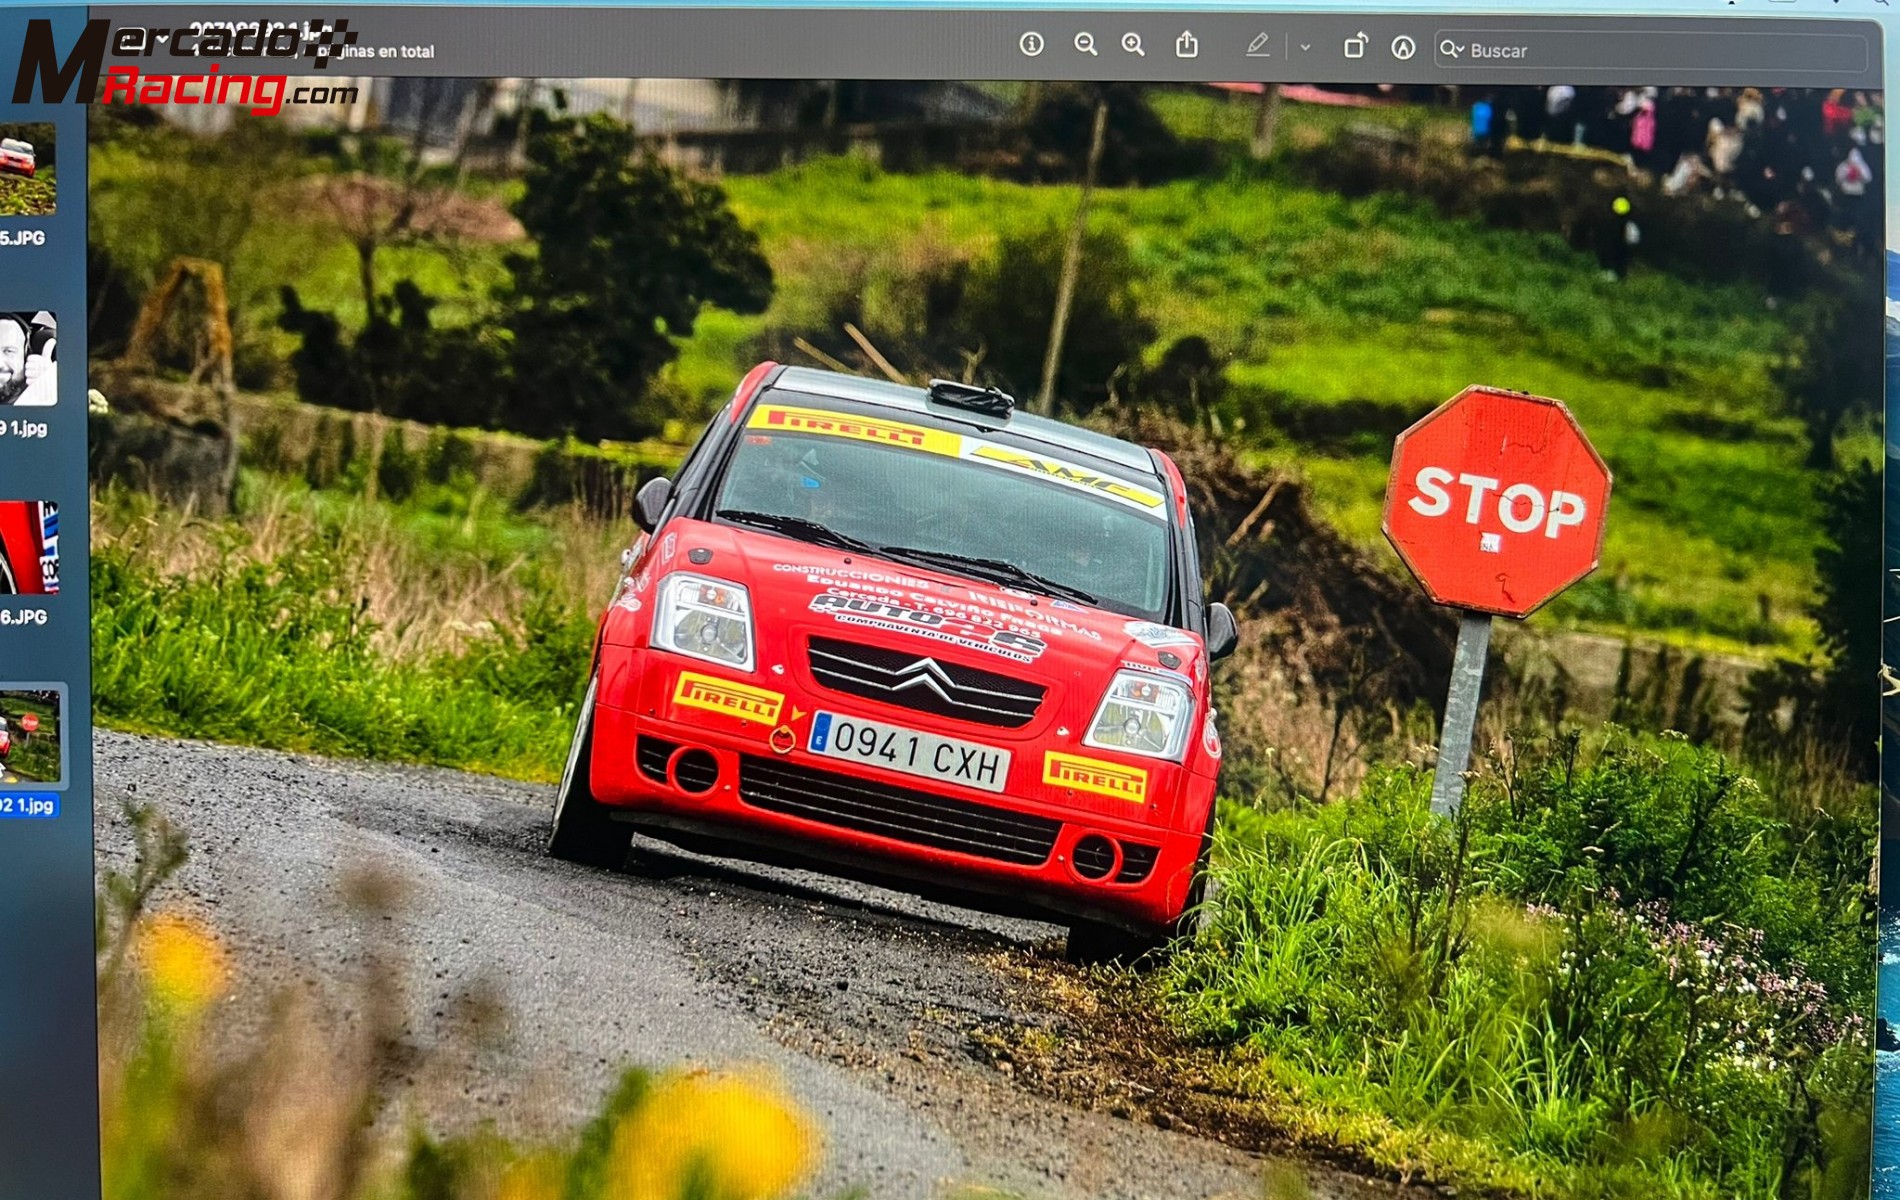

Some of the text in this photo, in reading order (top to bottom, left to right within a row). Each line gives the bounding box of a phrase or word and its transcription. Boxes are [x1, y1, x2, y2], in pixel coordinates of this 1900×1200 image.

[378, 46, 398, 58] en
[401, 44, 435, 58] total
[1471, 43, 1528, 58] Buscar
[10, 419, 48, 438] 1.jpg
[767, 410, 926, 446] PIRELLI
[1407, 466, 1586, 540] STOP
[0, 608, 48, 625] 6.JPG
[932, 606, 968, 620] 696
[680, 678, 780, 718] PIRELLI
[815, 735, 823, 745] E
[835, 722, 1000, 785] 0941 CXH
[1049, 758, 1144, 796] PIRELLI
[17, 797, 54, 815] 1.jpg
